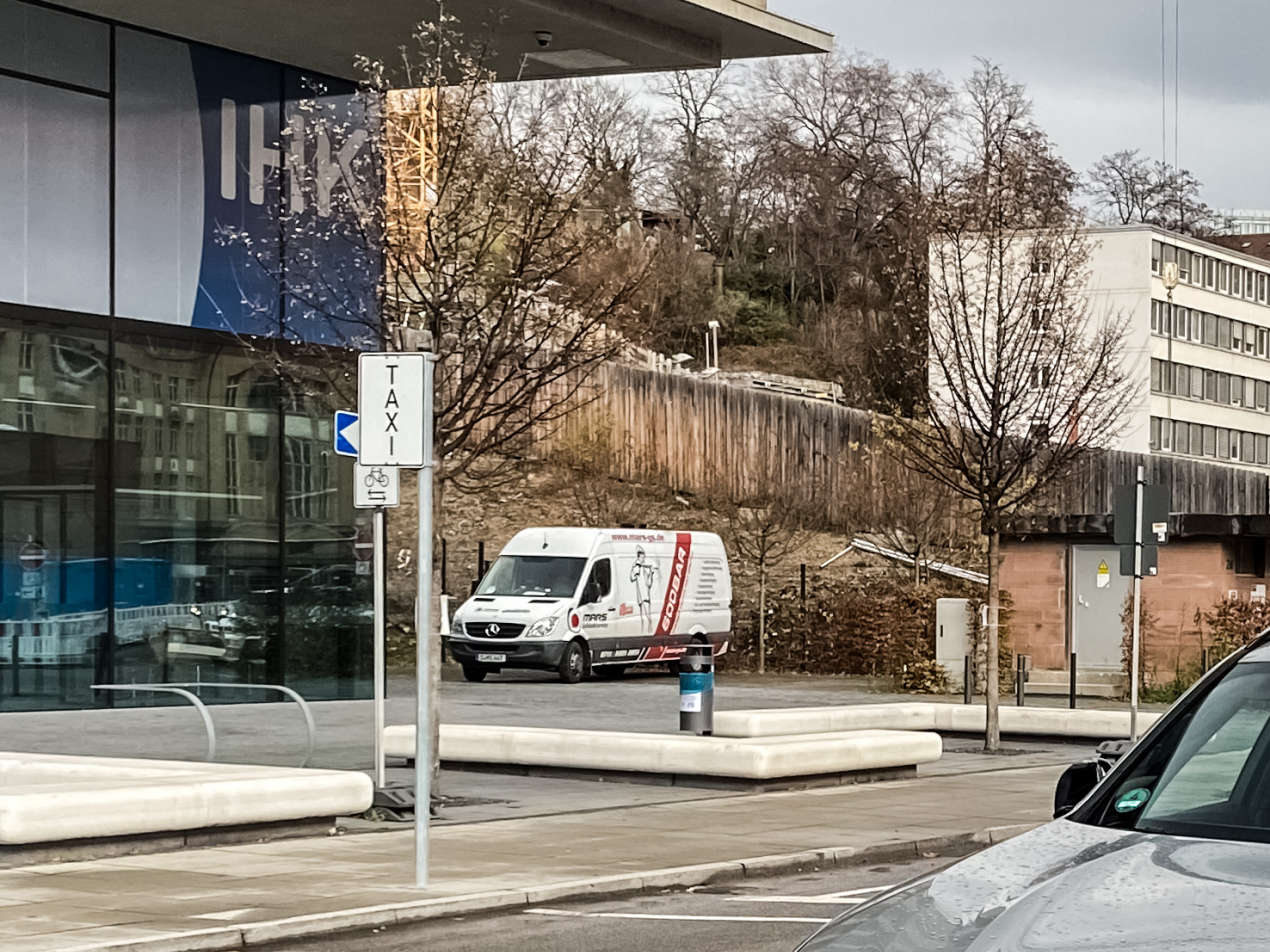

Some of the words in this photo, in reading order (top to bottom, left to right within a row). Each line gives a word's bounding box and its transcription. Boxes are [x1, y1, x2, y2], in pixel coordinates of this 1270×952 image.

[220, 98, 372, 219] IHK
[384, 365, 399, 456] TAXI
[583, 613, 608, 621] MARS
